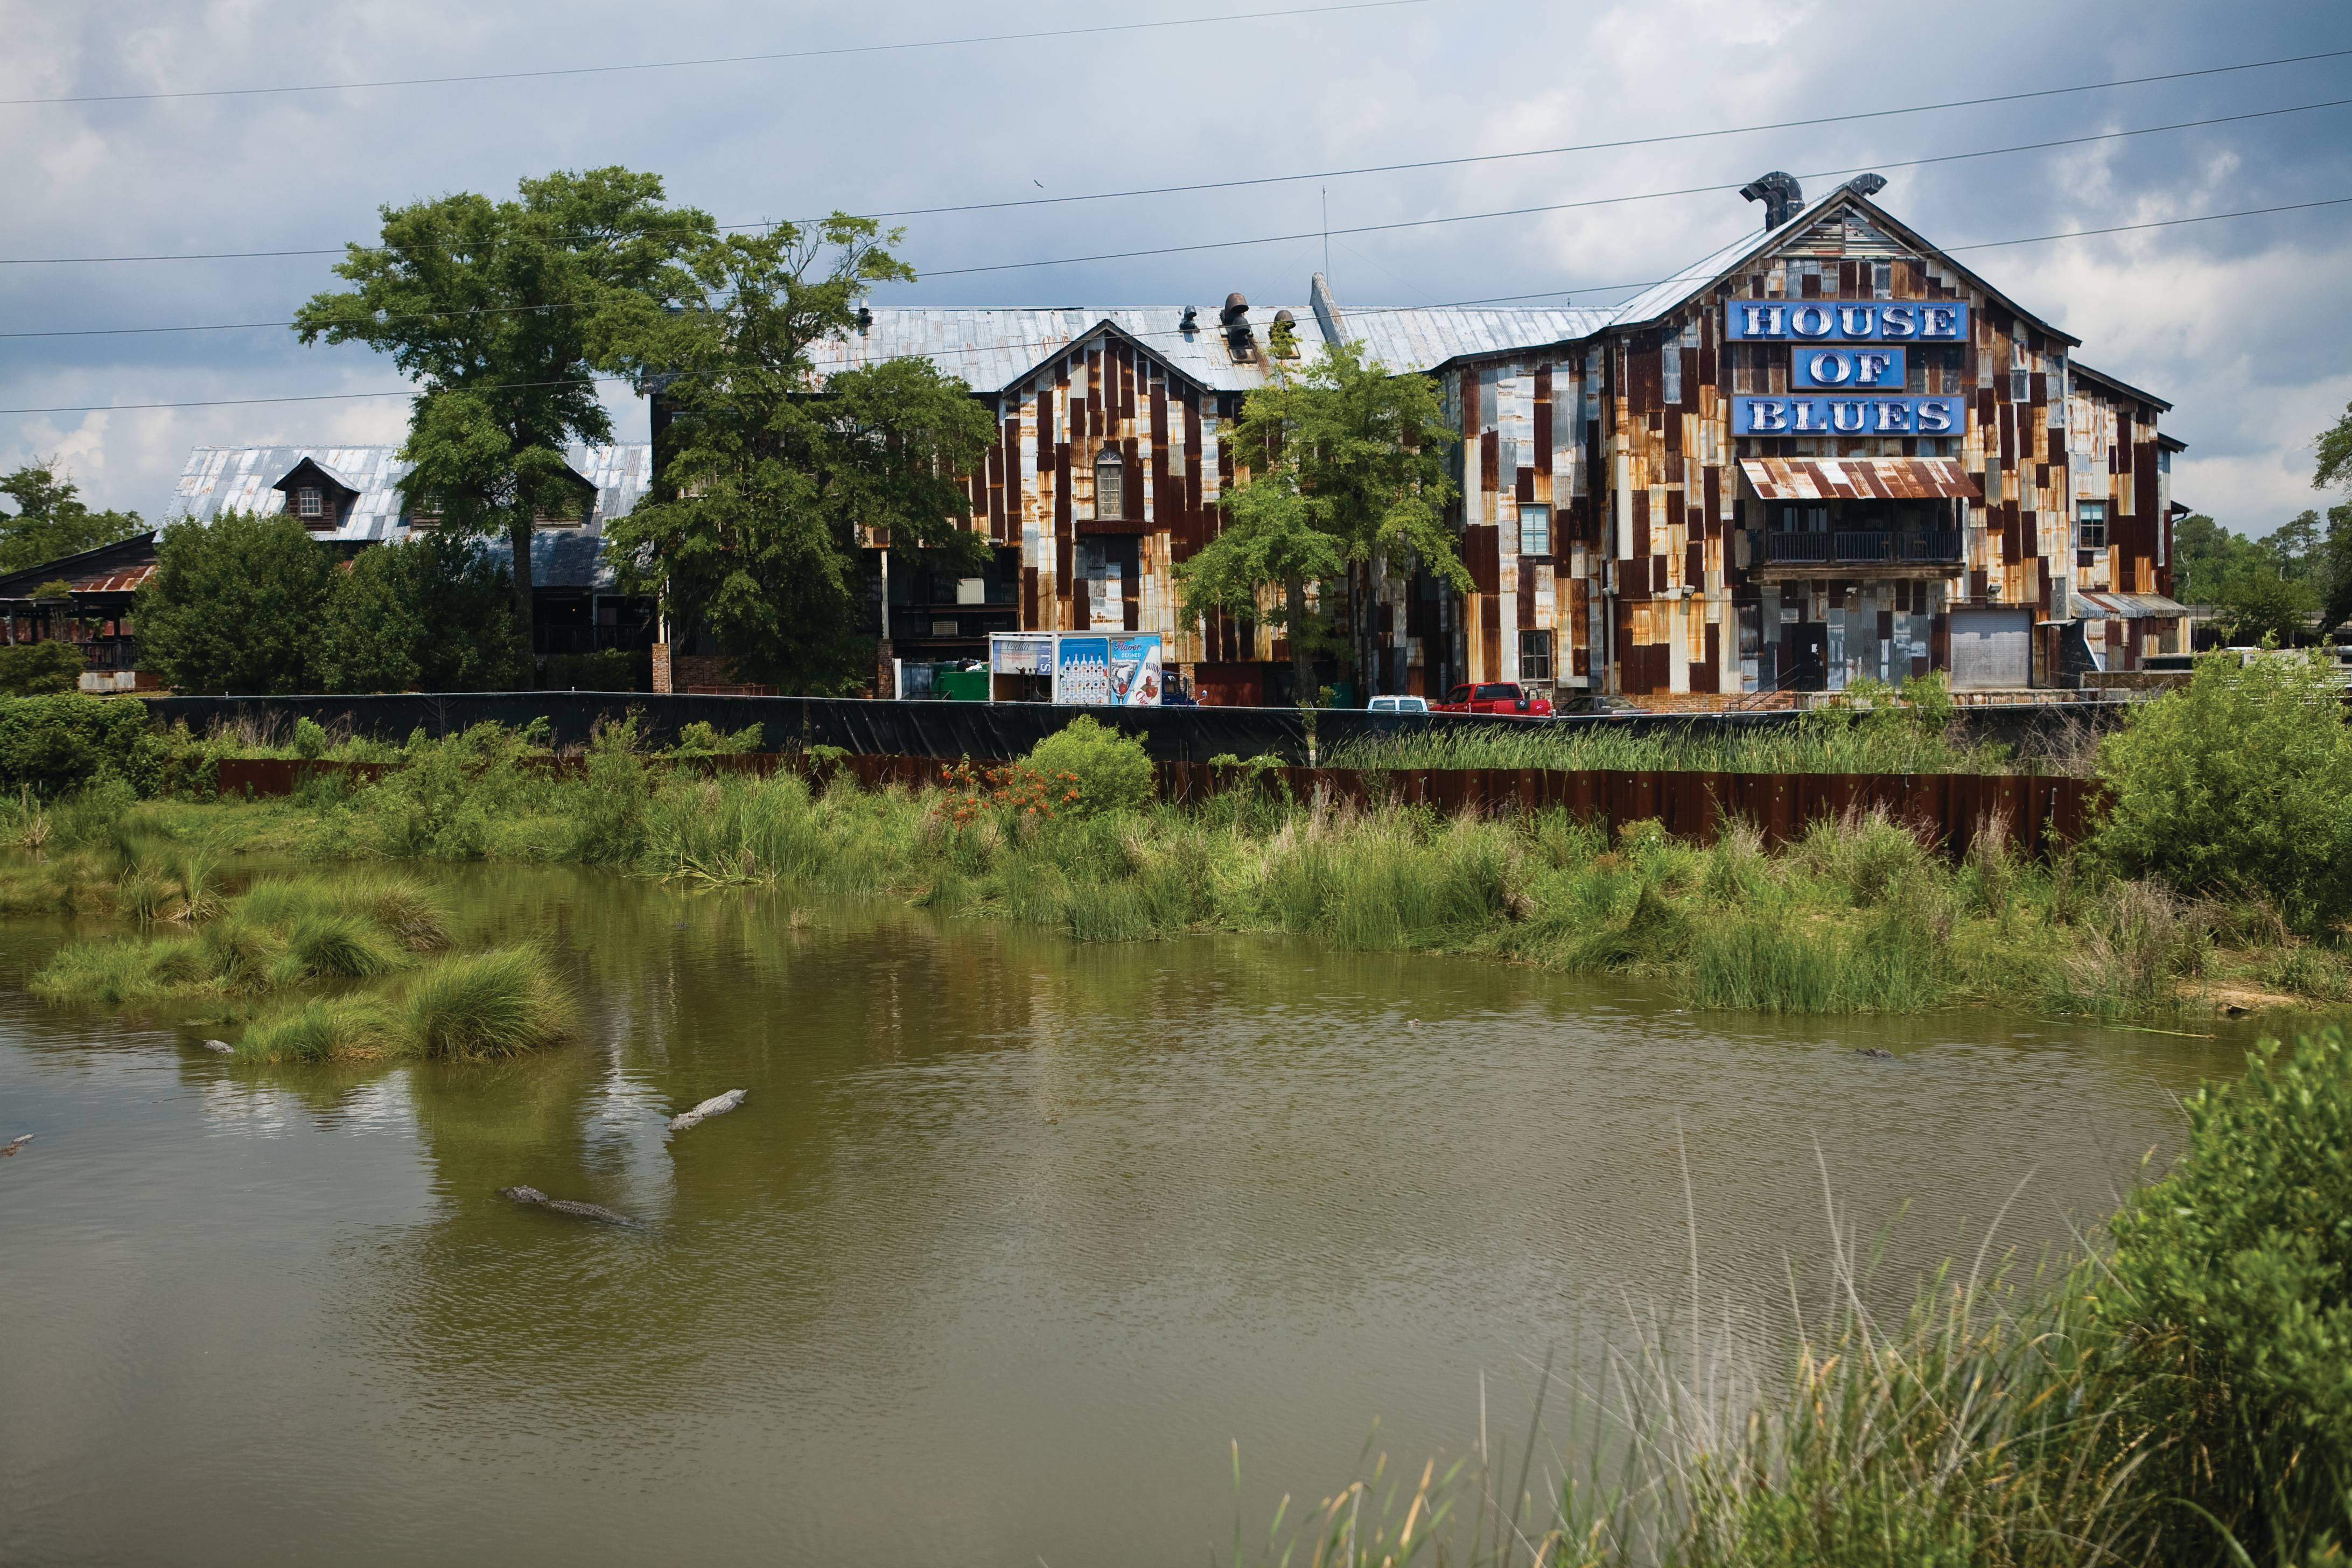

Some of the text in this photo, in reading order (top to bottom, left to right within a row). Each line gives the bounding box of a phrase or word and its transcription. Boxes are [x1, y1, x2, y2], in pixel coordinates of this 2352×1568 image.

[1743, 305, 1956, 336] HOUSE
[1810, 352, 1891, 383] OF
[1748, 400, 1951, 430] BLUES
[1005, 641, 1030, 651] Vodka
[1112, 641, 1142, 651] Flavor
